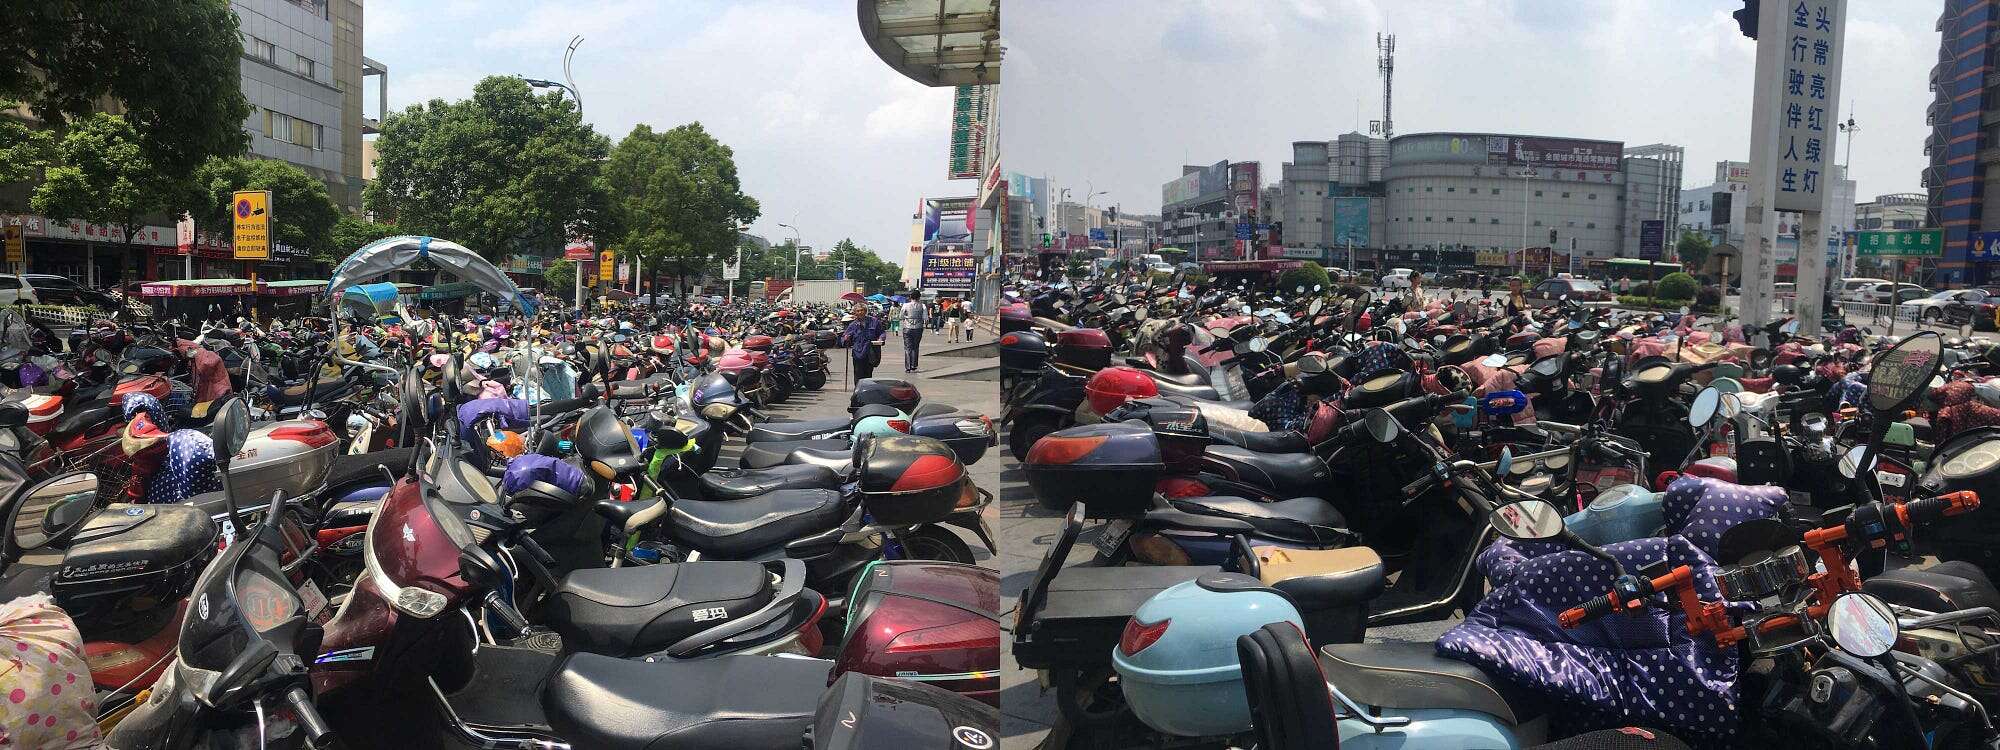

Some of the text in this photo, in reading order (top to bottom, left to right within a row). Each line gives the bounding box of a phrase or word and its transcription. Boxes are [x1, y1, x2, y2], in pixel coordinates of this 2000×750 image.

[1869, 233, 1932, 246] 招商北路
[691, 606, 728, 622] 爱玛
